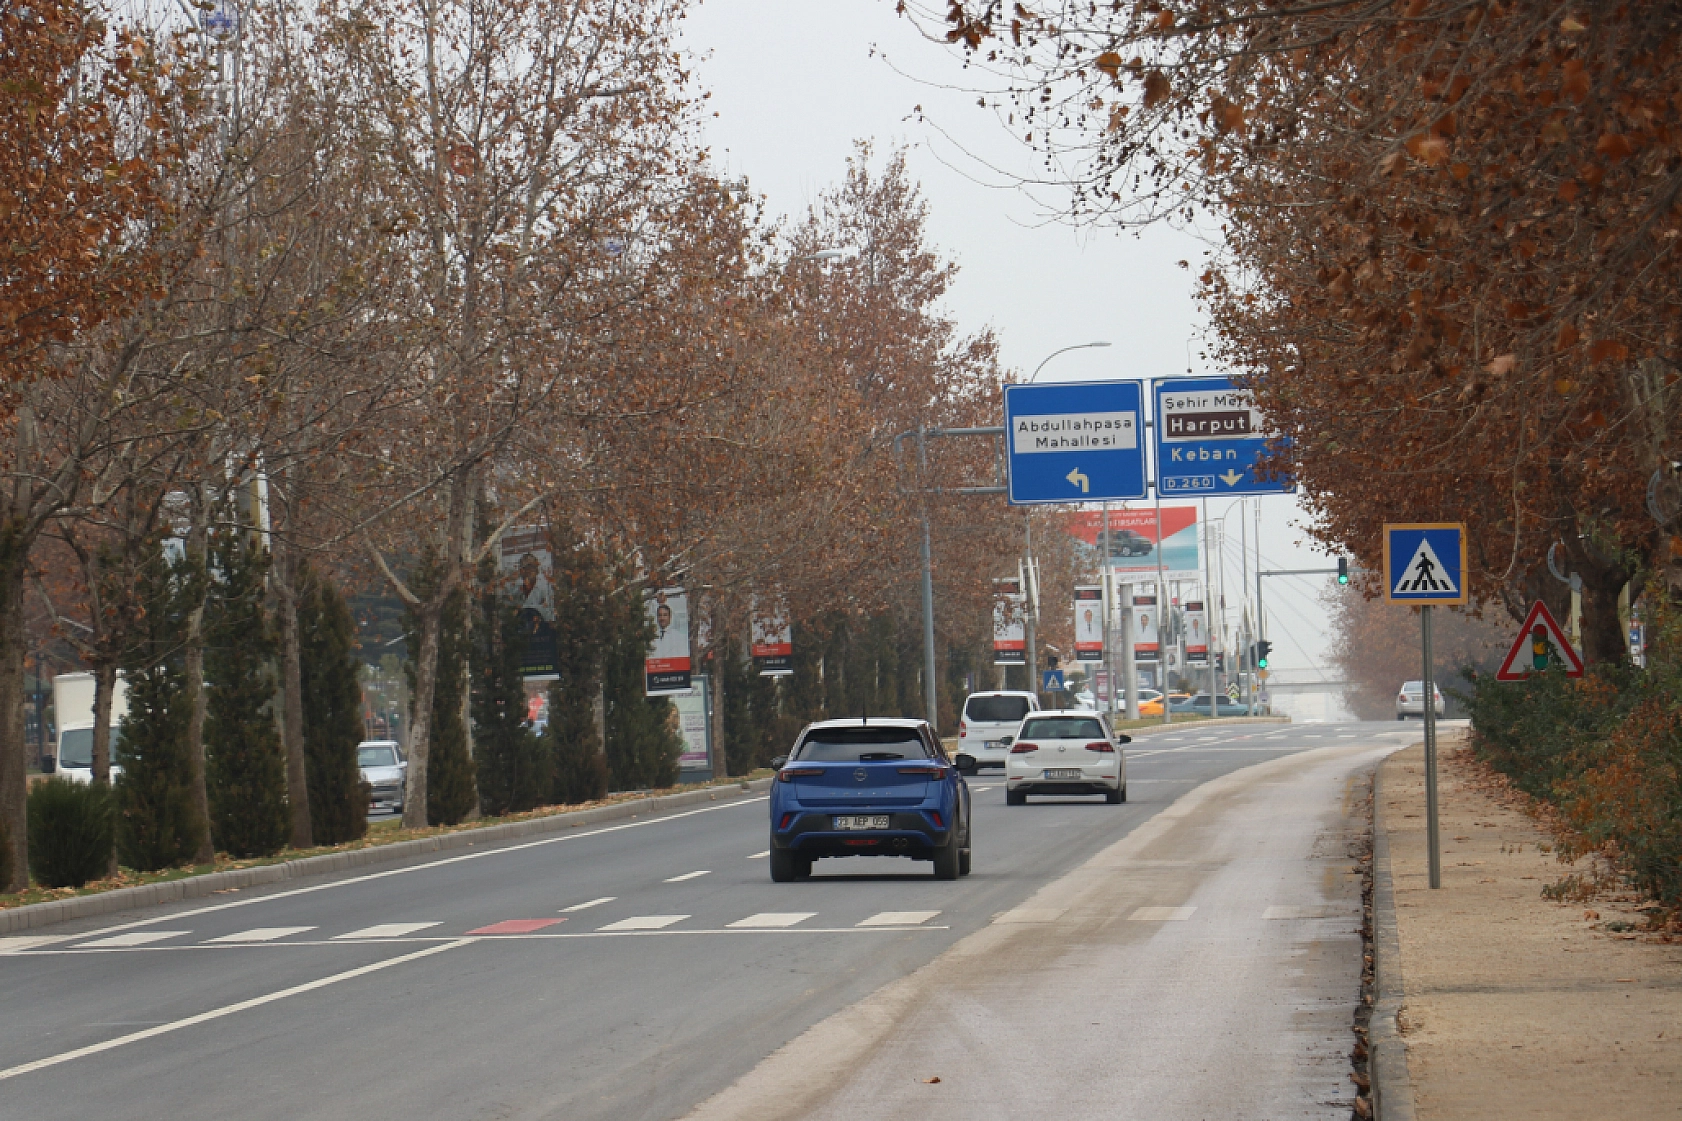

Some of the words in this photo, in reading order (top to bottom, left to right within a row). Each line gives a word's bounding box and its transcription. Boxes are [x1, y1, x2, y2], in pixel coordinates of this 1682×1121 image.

[1171, 416, 1245, 433] Harput
[1035, 434, 1116, 449] Mahallesi
[1171, 448, 1237, 462] Keban
[1167, 477, 1211, 488] D.260
